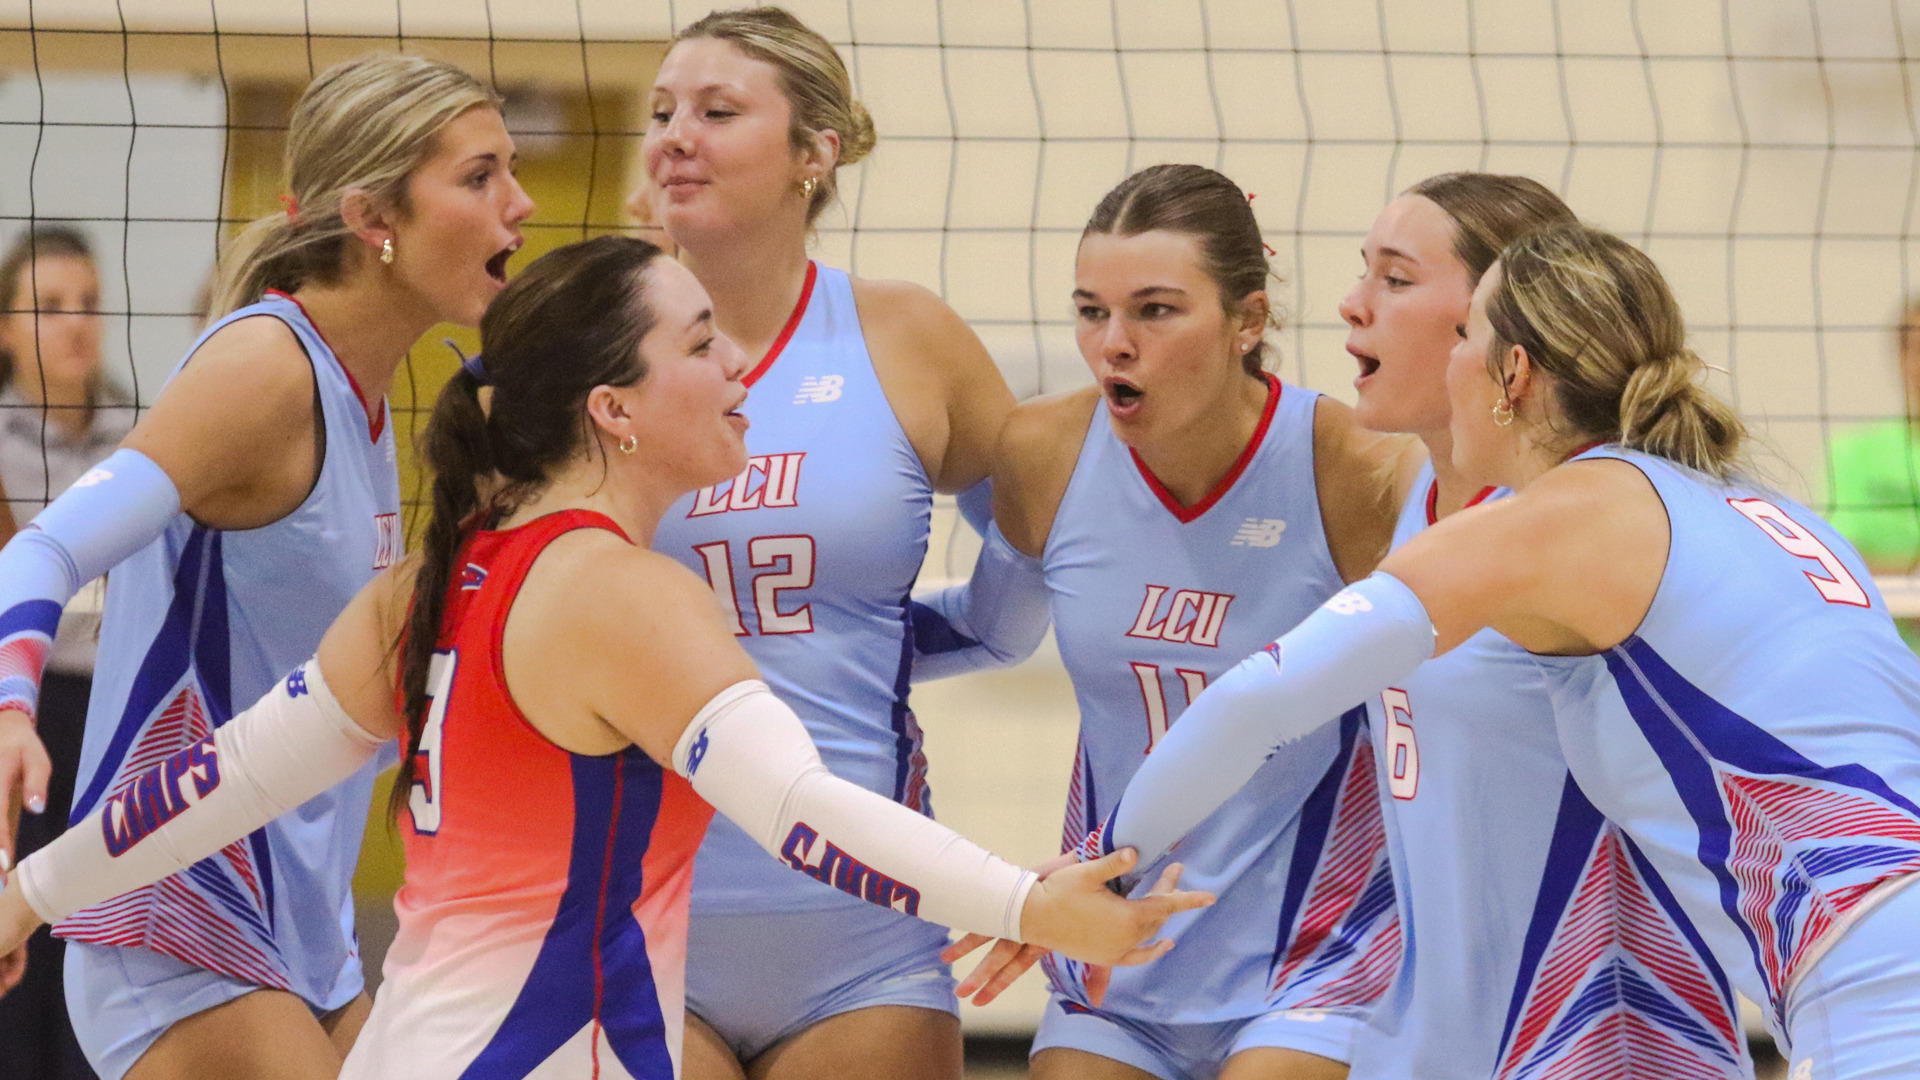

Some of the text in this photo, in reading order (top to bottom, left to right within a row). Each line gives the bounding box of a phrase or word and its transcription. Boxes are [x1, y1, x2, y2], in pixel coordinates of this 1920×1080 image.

[691, 534, 816, 637] 12
[1726, 497, 1871, 609] 9
[1125, 584, 1236, 648] LCU
[1380, 686, 1420, 801] 6
